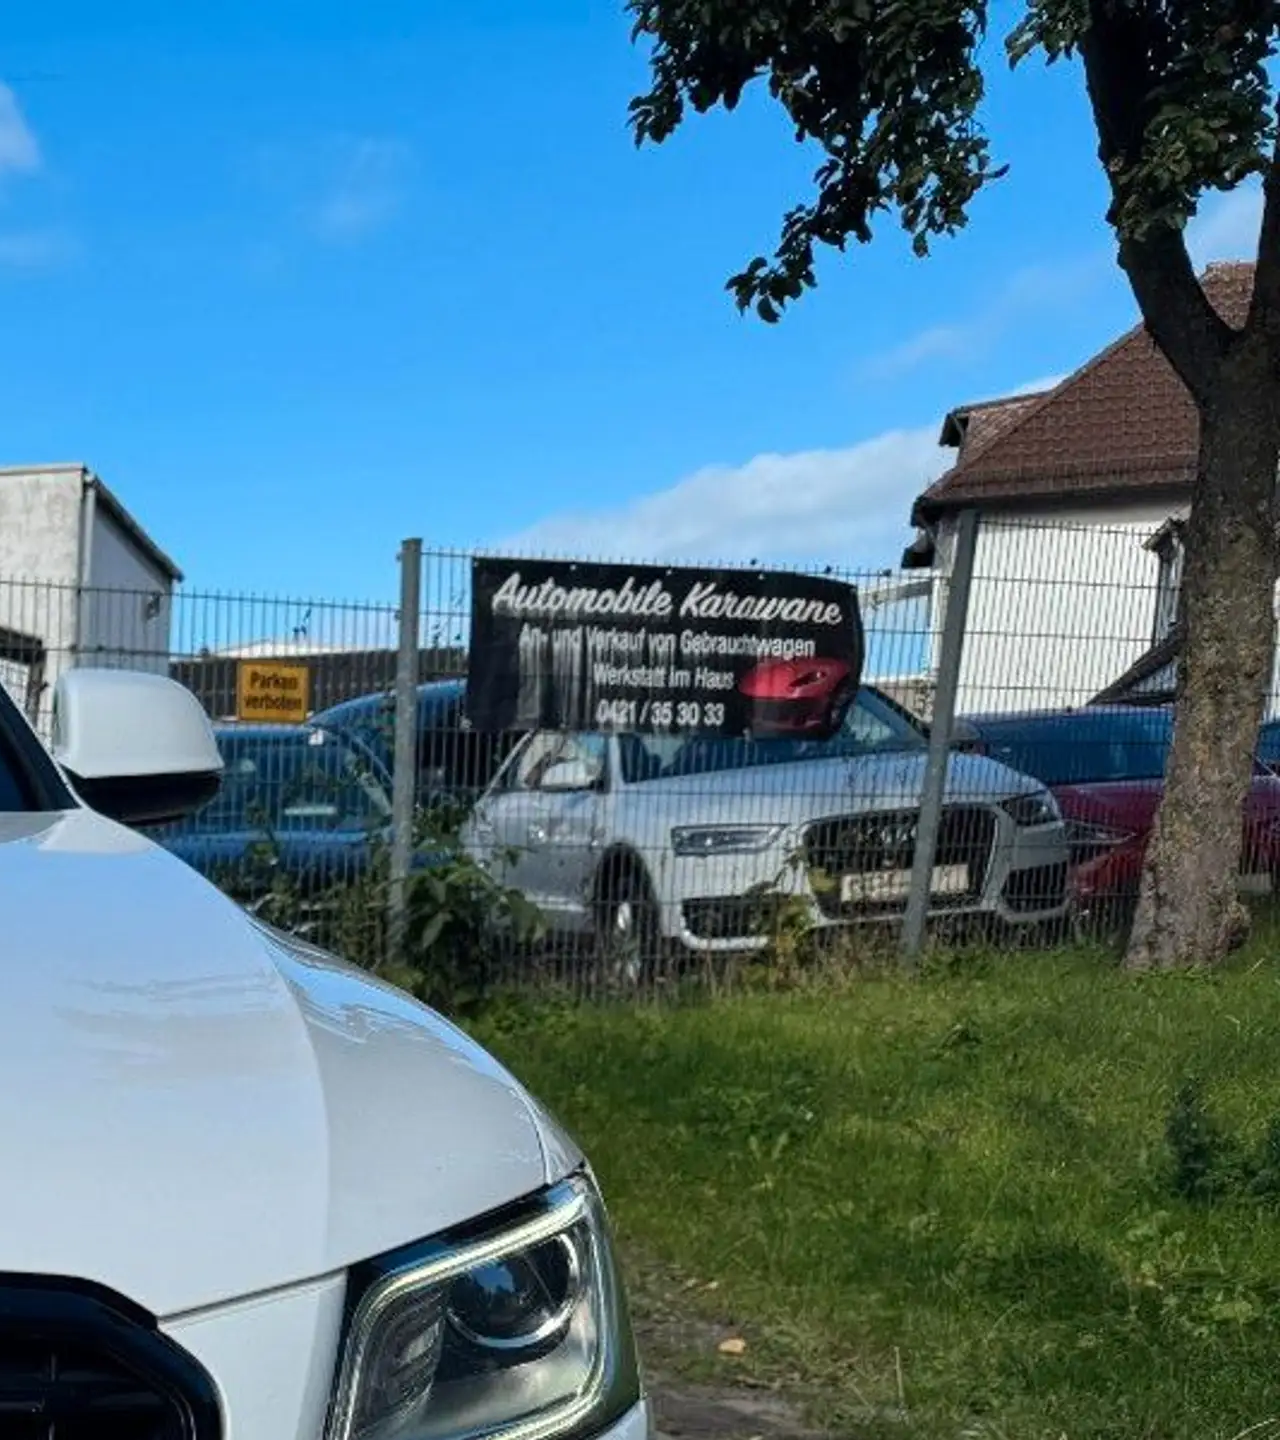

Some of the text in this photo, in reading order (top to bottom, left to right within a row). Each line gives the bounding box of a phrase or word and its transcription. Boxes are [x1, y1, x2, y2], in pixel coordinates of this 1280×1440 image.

[492, 572, 842, 626] Automobile Karawane
[552, 625, 582, 652] und
[586, 625, 646, 652] Verkauf
[649, 631, 676, 652] von
[680, 629, 816, 660] Gebrauchtwagen
[593, 663, 734, 690] Werkstatt im Haus
[596, 699, 636, 724] 0421
[651, 702, 672, 726] 35
[676, 702, 700, 727] 30
[703, 702, 725, 727] 33
